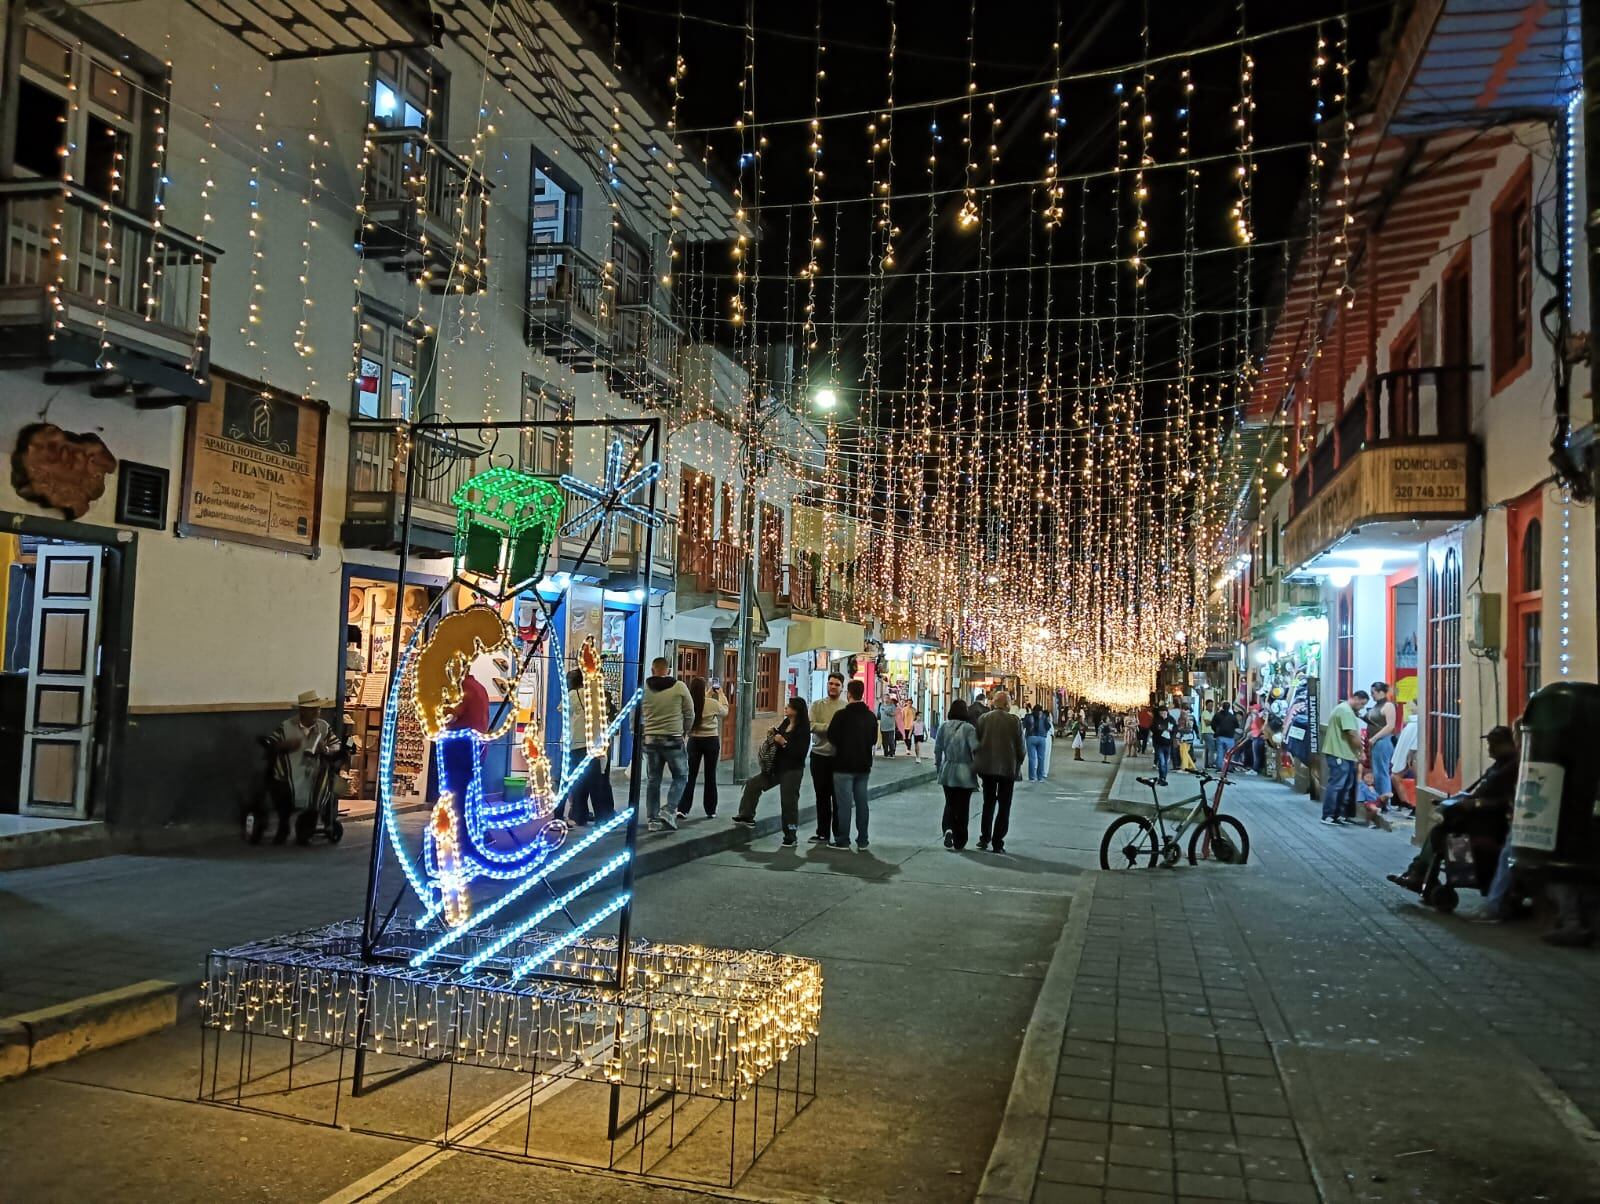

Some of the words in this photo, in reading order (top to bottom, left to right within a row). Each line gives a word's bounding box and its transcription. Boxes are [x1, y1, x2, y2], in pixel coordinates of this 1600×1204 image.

[205, 438, 235, 454] APARTA
[237, 446, 264, 461] HOTEL
[266, 454, 281, 465] DEL
[282, 459, 310, 473] PARQUE
[1395, 458, 1458, 471] DOMICILIOS
[232, 460, 285, 485] FILANDIA
[1395, 486, 1413, 498] 320
[1436, 486, 1460, 498] 3331
[1309, 695, 1317, 753] RESTAURANTE
